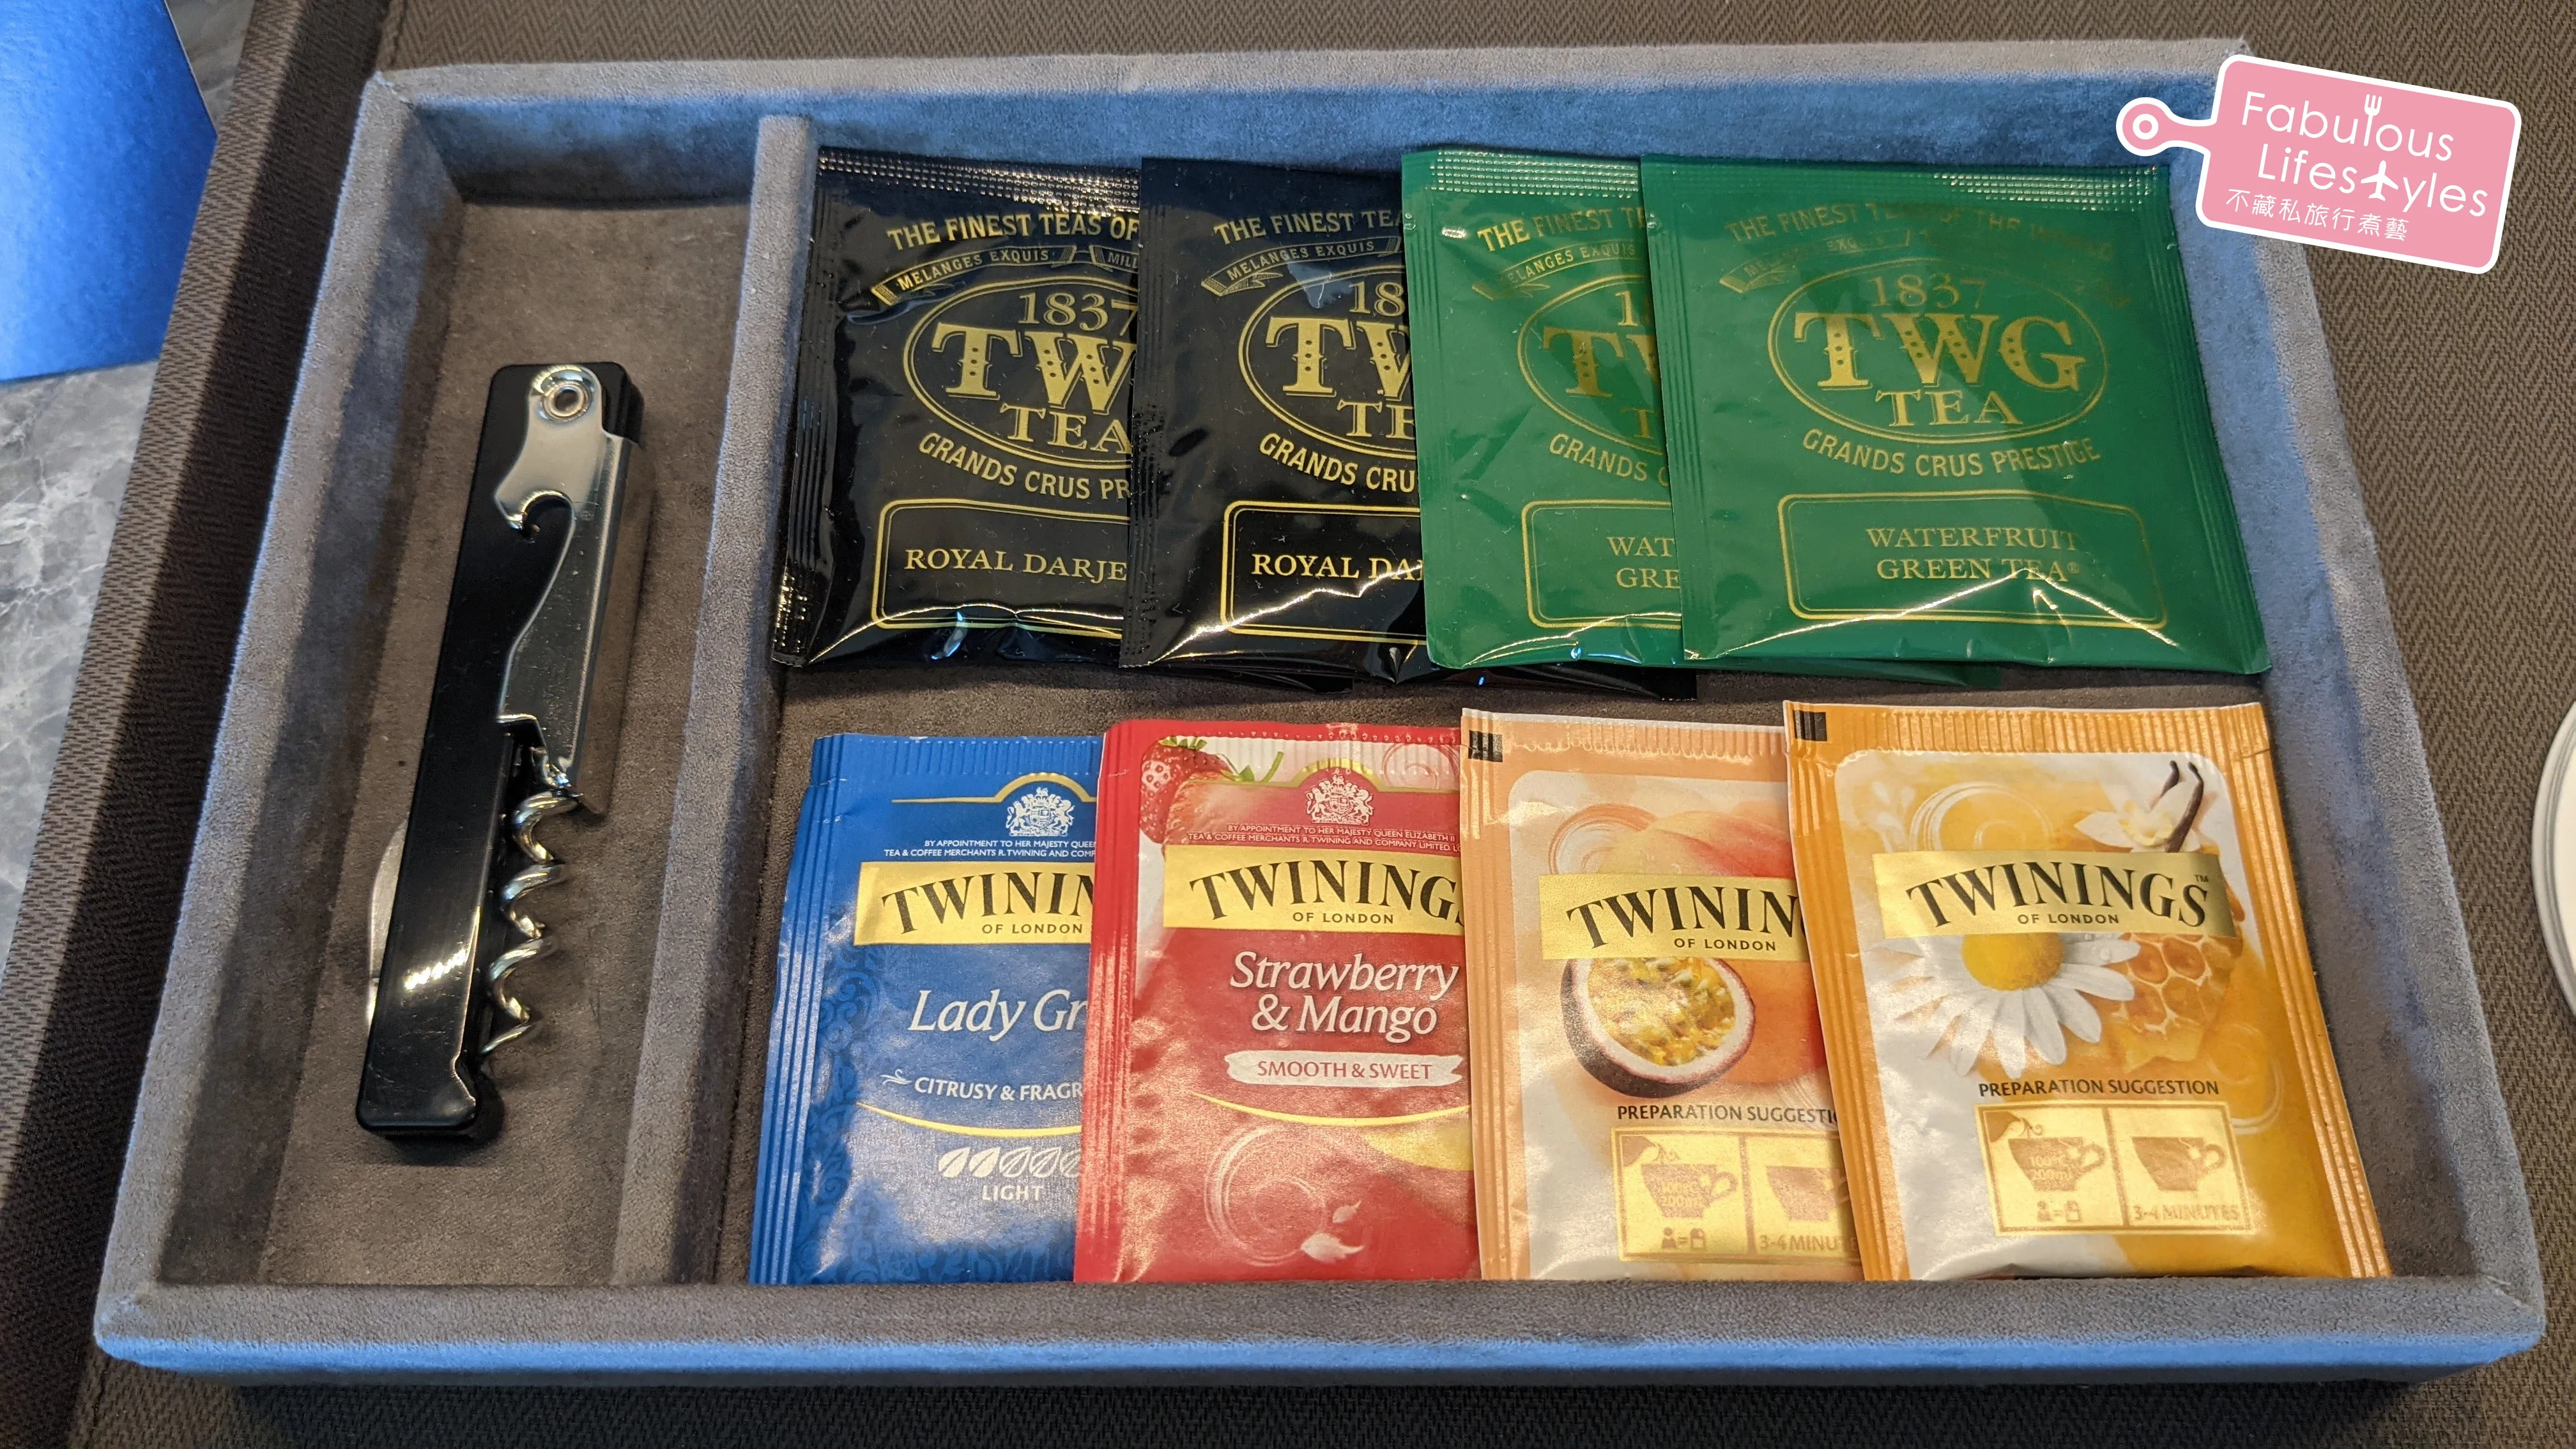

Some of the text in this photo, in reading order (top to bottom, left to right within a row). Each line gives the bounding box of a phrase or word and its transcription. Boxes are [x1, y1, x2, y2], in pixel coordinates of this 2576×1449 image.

[887, 212, 1139, 251] THE FINEST TEAS OF
[1213, 217, 1266, 245] THE
[1273, 211, 1354, 234] FINEST
[1477, 218, 1531, 253] THE
[1531, 208, 1614, 238] FINEST
[1725, 216, 1777, 242] THE
[1777, 204, 1857, 233] FINEST
[898, 249, 1050, 291] MELANGES EXQUIS
[1226, 240, 1375, 282] MELANGES EXQUIS
[1349, 280, 1406, 318] 18
[1871, 273, 1987, 309] 1837
[1018, 291, 1138, 337] 1837
[931, 322, 1137, 415] TW
[1794, 311, 2087, 392] TWG
[1875, 390, 2024, 428] TEA
[1000, 402, 1132, 455] TEA
[919, 432, 1131, 500] GRANDS CRUS PR
[1259, 433, 1416, 493] GRANDS CRU
[1549, 433, 1648, 482] GRANDS
[1802, 428, 2101, 478] GRANDS CRUS PRESTIGE
[1607, 536, 1676, 557] WAT
[1866, 526, 2079, 551] WATERFRUIT
[905, 548, 1128, 584] ROYAL DARJE
[1251, 553, 1360, 579] ROYAL
[1616, 567, 1680, 589] GRE
[1876, 558, 1993, 581] GREEN
[1215, 833, 1246, 841] COFFEE
[1248, 834, 1301, 843] MERCHANTS
[1311, 836, 1351, 844] TWINING
[1375, 838, 1417, 848] COMPANY
[1240, 825, 1301, 834] APPOINTMENT
[1337, 828, 1372, 836] MAJESTY
[1374, 830, 1403, 839] QUEEN
[1405, 831, 1448, 841] ELIZABETH
[1190, 860, 1464, 928] TWINING
[1906, 861, 2208, 928] TWININGS
[982, 924, 1082, 934] OF LONDON
[1292, 912, 1393, 924] OF LONDON
[1566, 886, 1807, 950] TWININ
[2018, 913, 2120, 926] OF LONDON
[1674, 938, 1777, 951] OF LONDON
[1230, 951, 1459, 1001] Strawberry
[908, 989, 1027, 1042] Lady
[1251, 993, 1438, 1043] & Mango
[914, 1077, 1083, 1101] CITRUSY & FRAGR
[1257, 1061, 1432, 1080] SMOOTH & SWEET
[1978, 1080, 2219, 1097] PREPARATION SUGGESTION
[1617, 1105, 1742, 1121] PREPARATION
[982, 1184, 1044, 1202] LIGHT
